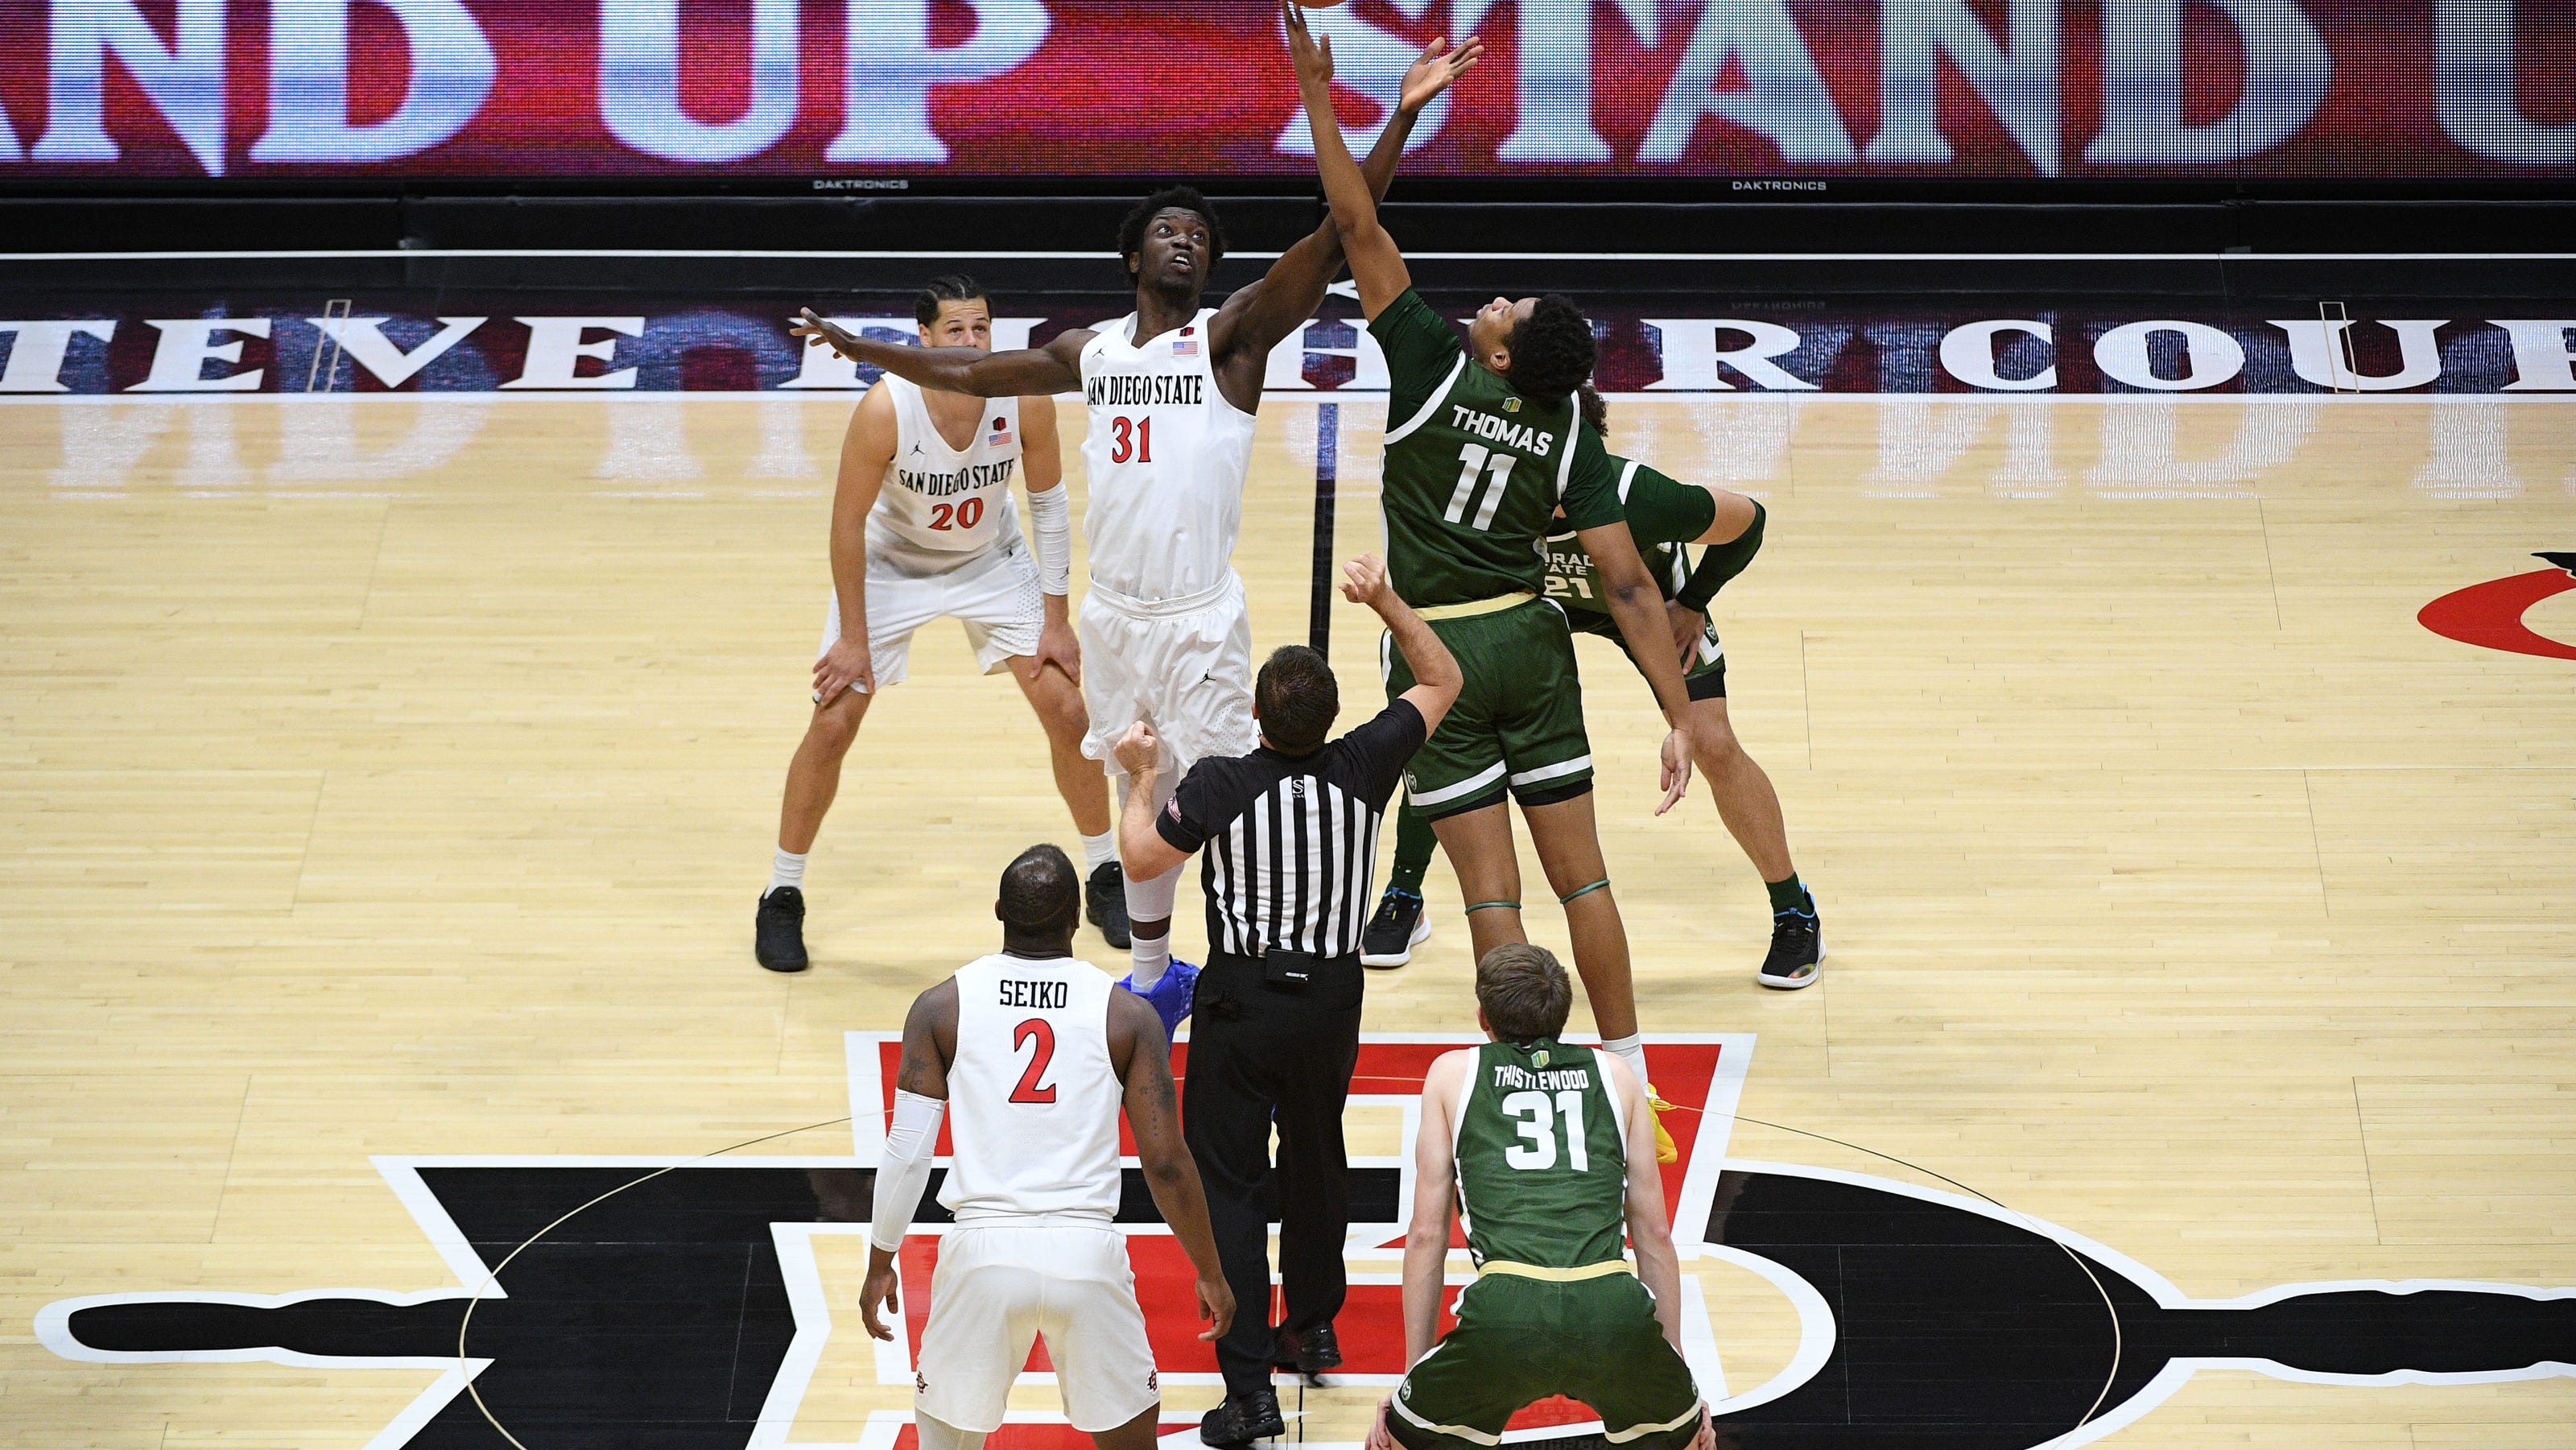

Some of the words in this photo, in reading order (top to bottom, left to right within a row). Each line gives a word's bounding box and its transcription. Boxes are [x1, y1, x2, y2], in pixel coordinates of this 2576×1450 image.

[0, 0, 497, 177] ND
[599, 0, 1051, 163] UP
[1274, 0, 2335, 177] STAND
[813, 180, 909, 189] DAKTRONICS
[1732, 180, 1827, 190] DAKTRONICS
[1087, 375, 1106, 406] SAN
[1108, 375, 1152, 406] DIEGO
[1154, 374, 1203, 405] STATE
[1112, 415, 1151, 464] 31
[1451, 404, 1554, 456] THOMAS
[899, 469, 925, 494] SAN
[927, 467, 969, 496] DIEGO
[972, 457, 1014, 490] STATE
[1443, 443, 1517, 531] 11
[927, 497, 984, 531] 20
[1543, 575, 1594, 599] 21
[1000, 979, 1068, 1009] SEIKO
[1008, 1018, 1056, 1104] 2
[1495, 1064, 1589, 1090] THISTLEWOOD
[1502, 1090, 1588, 1172] 31
